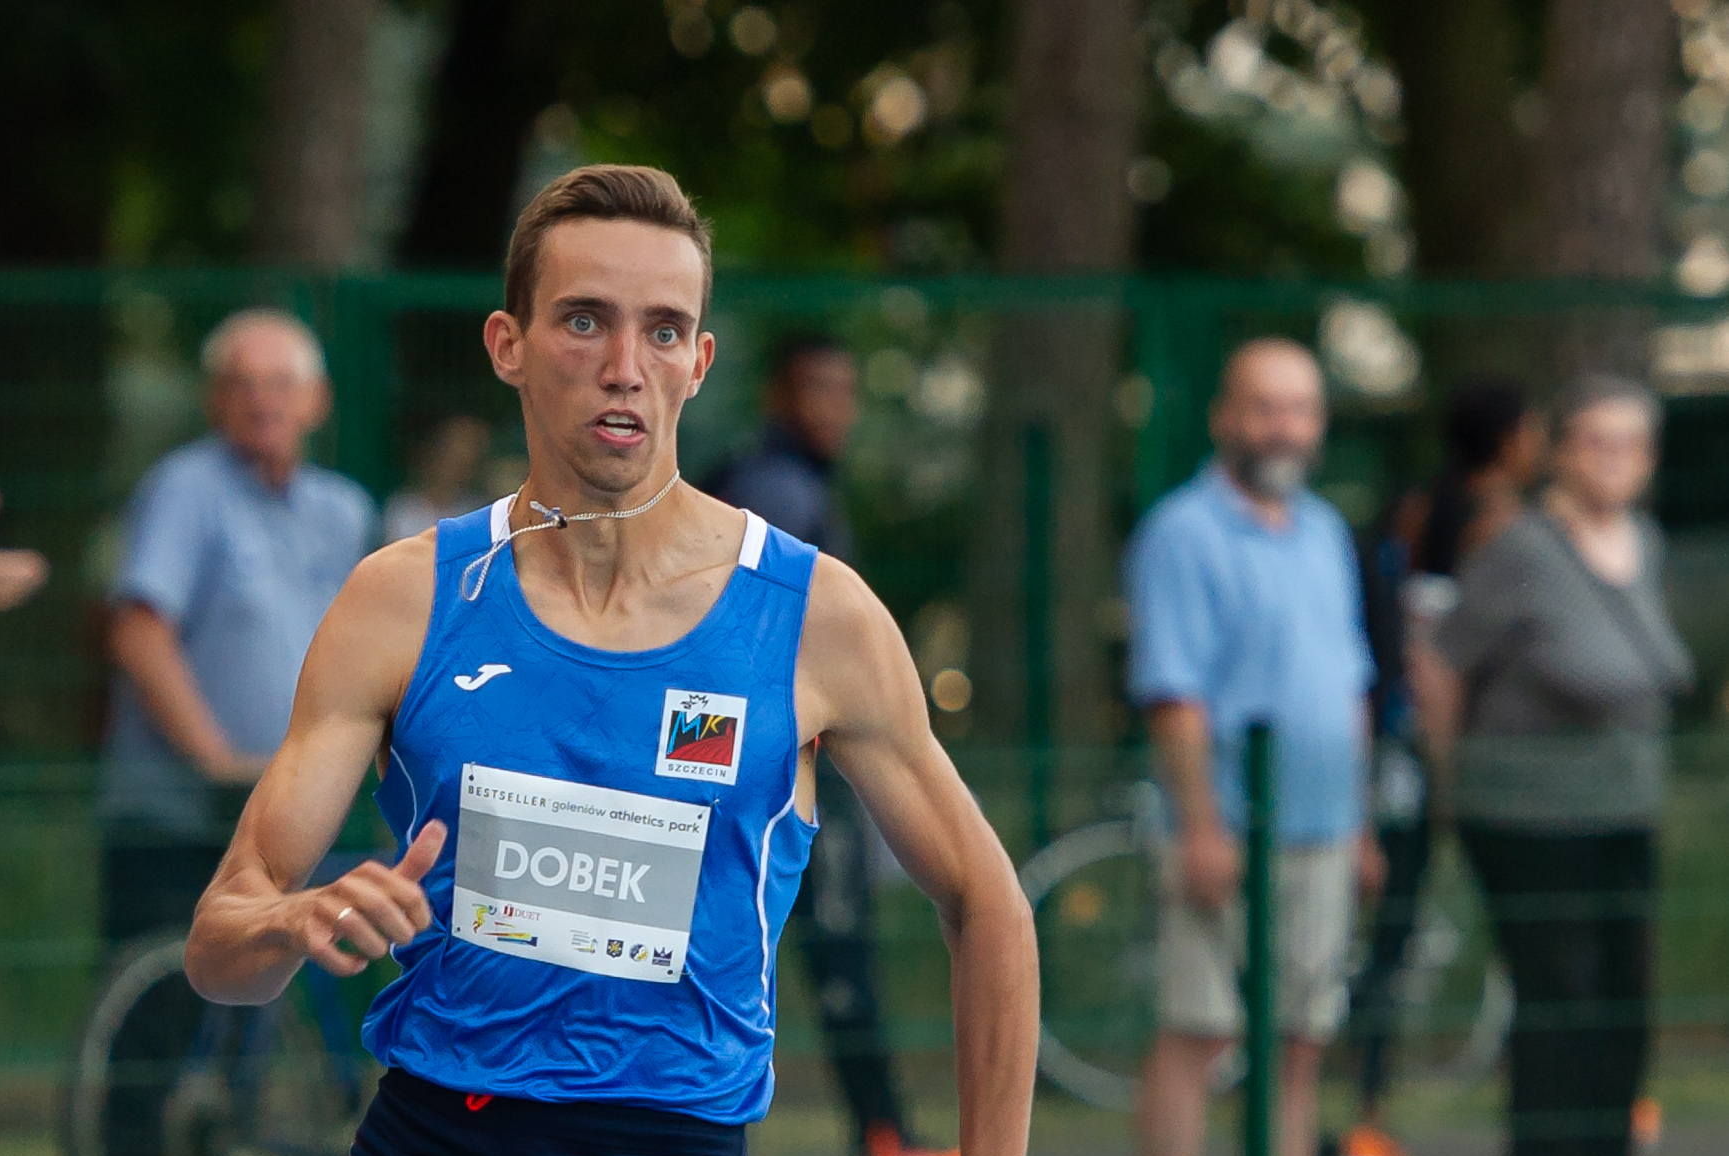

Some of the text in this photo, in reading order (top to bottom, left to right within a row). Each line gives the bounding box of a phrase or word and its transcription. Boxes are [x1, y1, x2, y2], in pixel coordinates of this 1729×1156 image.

[667, 763, 727, 779] SZCZECIN
[467, 785, 700, 833] BESTSELLER goleniów athletics park
[494, 839, 651, 903] DOBEK
